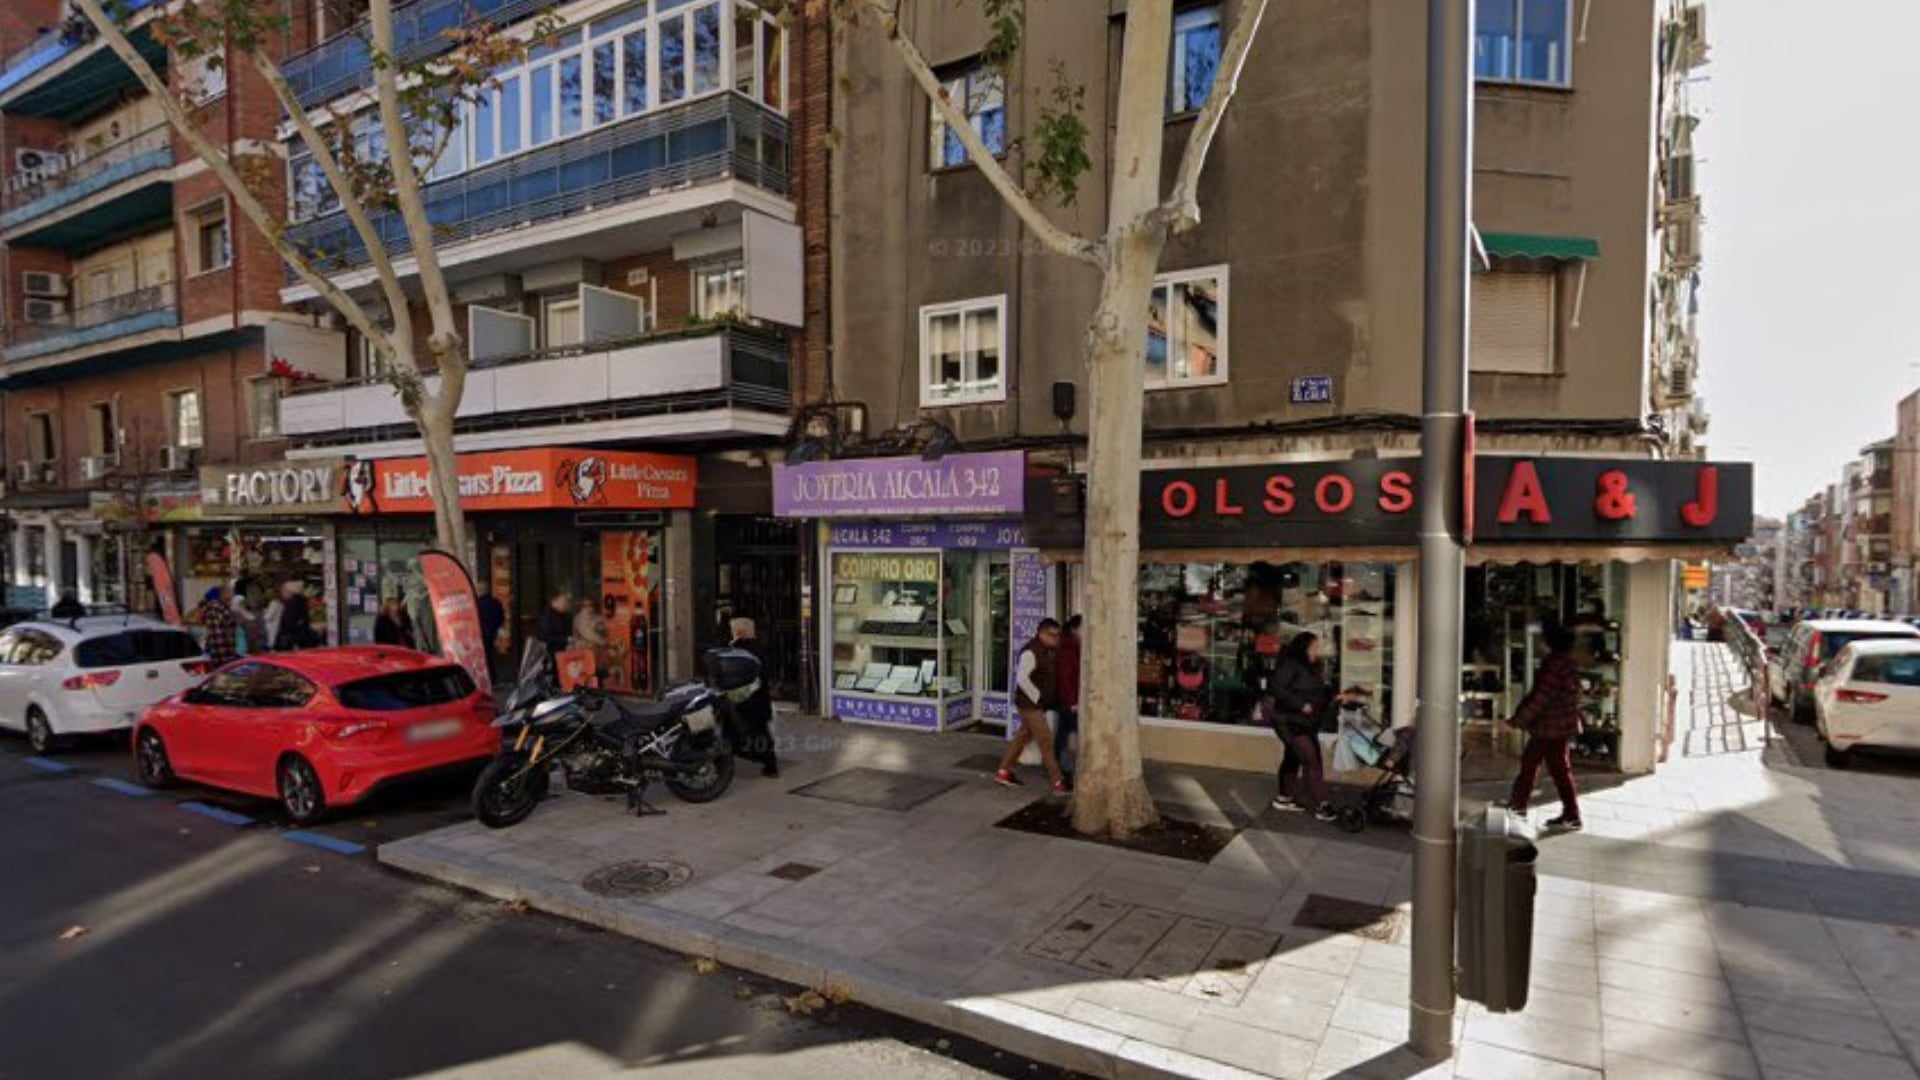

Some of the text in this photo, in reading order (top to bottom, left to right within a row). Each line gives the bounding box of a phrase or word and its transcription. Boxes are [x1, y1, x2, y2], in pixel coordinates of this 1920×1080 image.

[227, 469, 331, 504] FACTORY
[491, 465, 545, 494] Pizza
[963, 467, 1000, 497] 342
[1137, 461, 1718, 527] OLSOS A & J
[840, 557, 936, 580] COMPRO ORO
